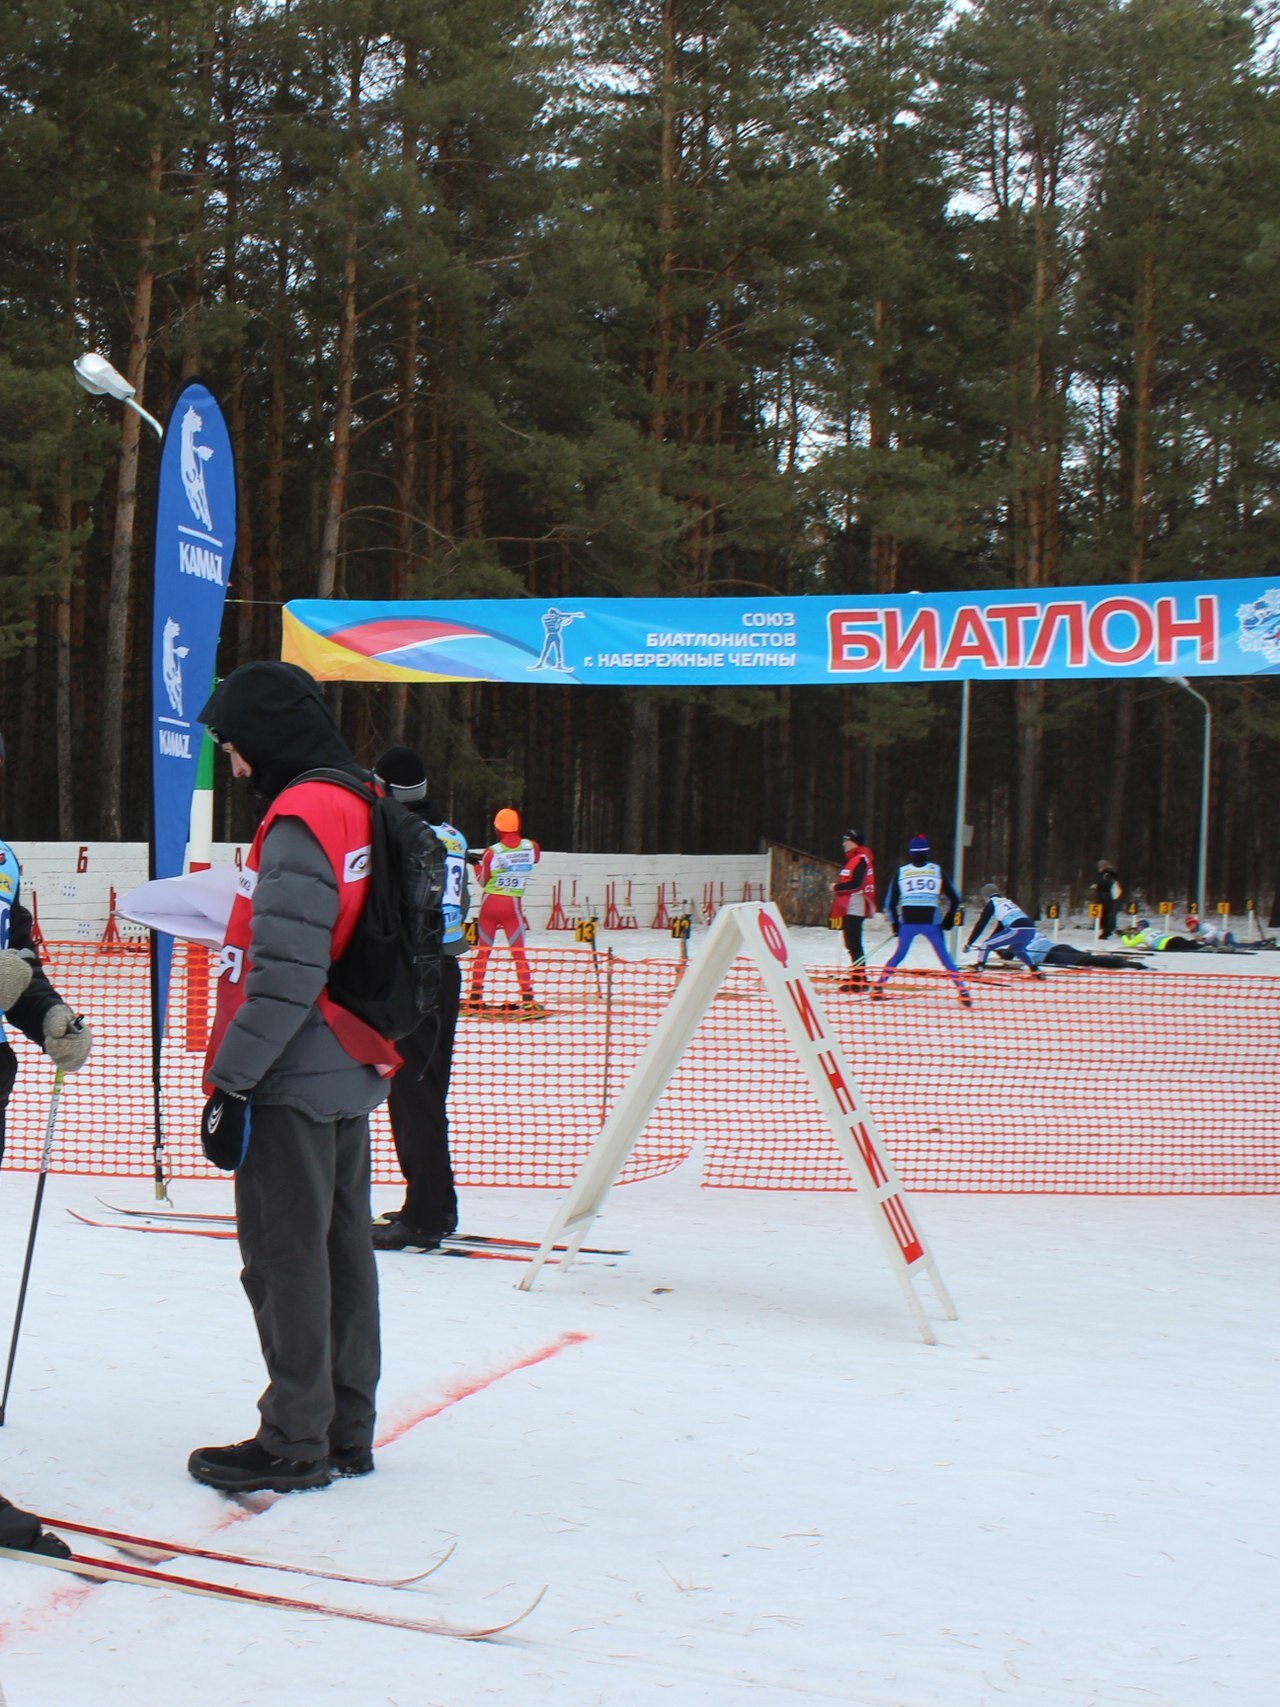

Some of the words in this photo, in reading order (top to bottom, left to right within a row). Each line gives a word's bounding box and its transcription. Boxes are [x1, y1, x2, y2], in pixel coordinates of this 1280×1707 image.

[178, 541, 224, 587] KAMAZ
[742, 612, 796, 628] СОЮЗ
[646, 632, 798, 648] БИАТЛОНИСТОВ
[826, 595, 1219, 673] БИАТЛОН
[583, 655, 594, 667] г.
[598, 652, 725, 668] НАБЕРЕЖНЫЕ
[728, 652, 797, 667] ЧЕЛНЫ
[159, 729, 193, 759] KAMAZ
[497, 878, 519, 888] 539
[906, 879, 936, 892] 150
[1190, 902, 1198, 914] 2
[577, 922, 595, 942] 13
[757, 908, 925, 1266] ФИНИШ
